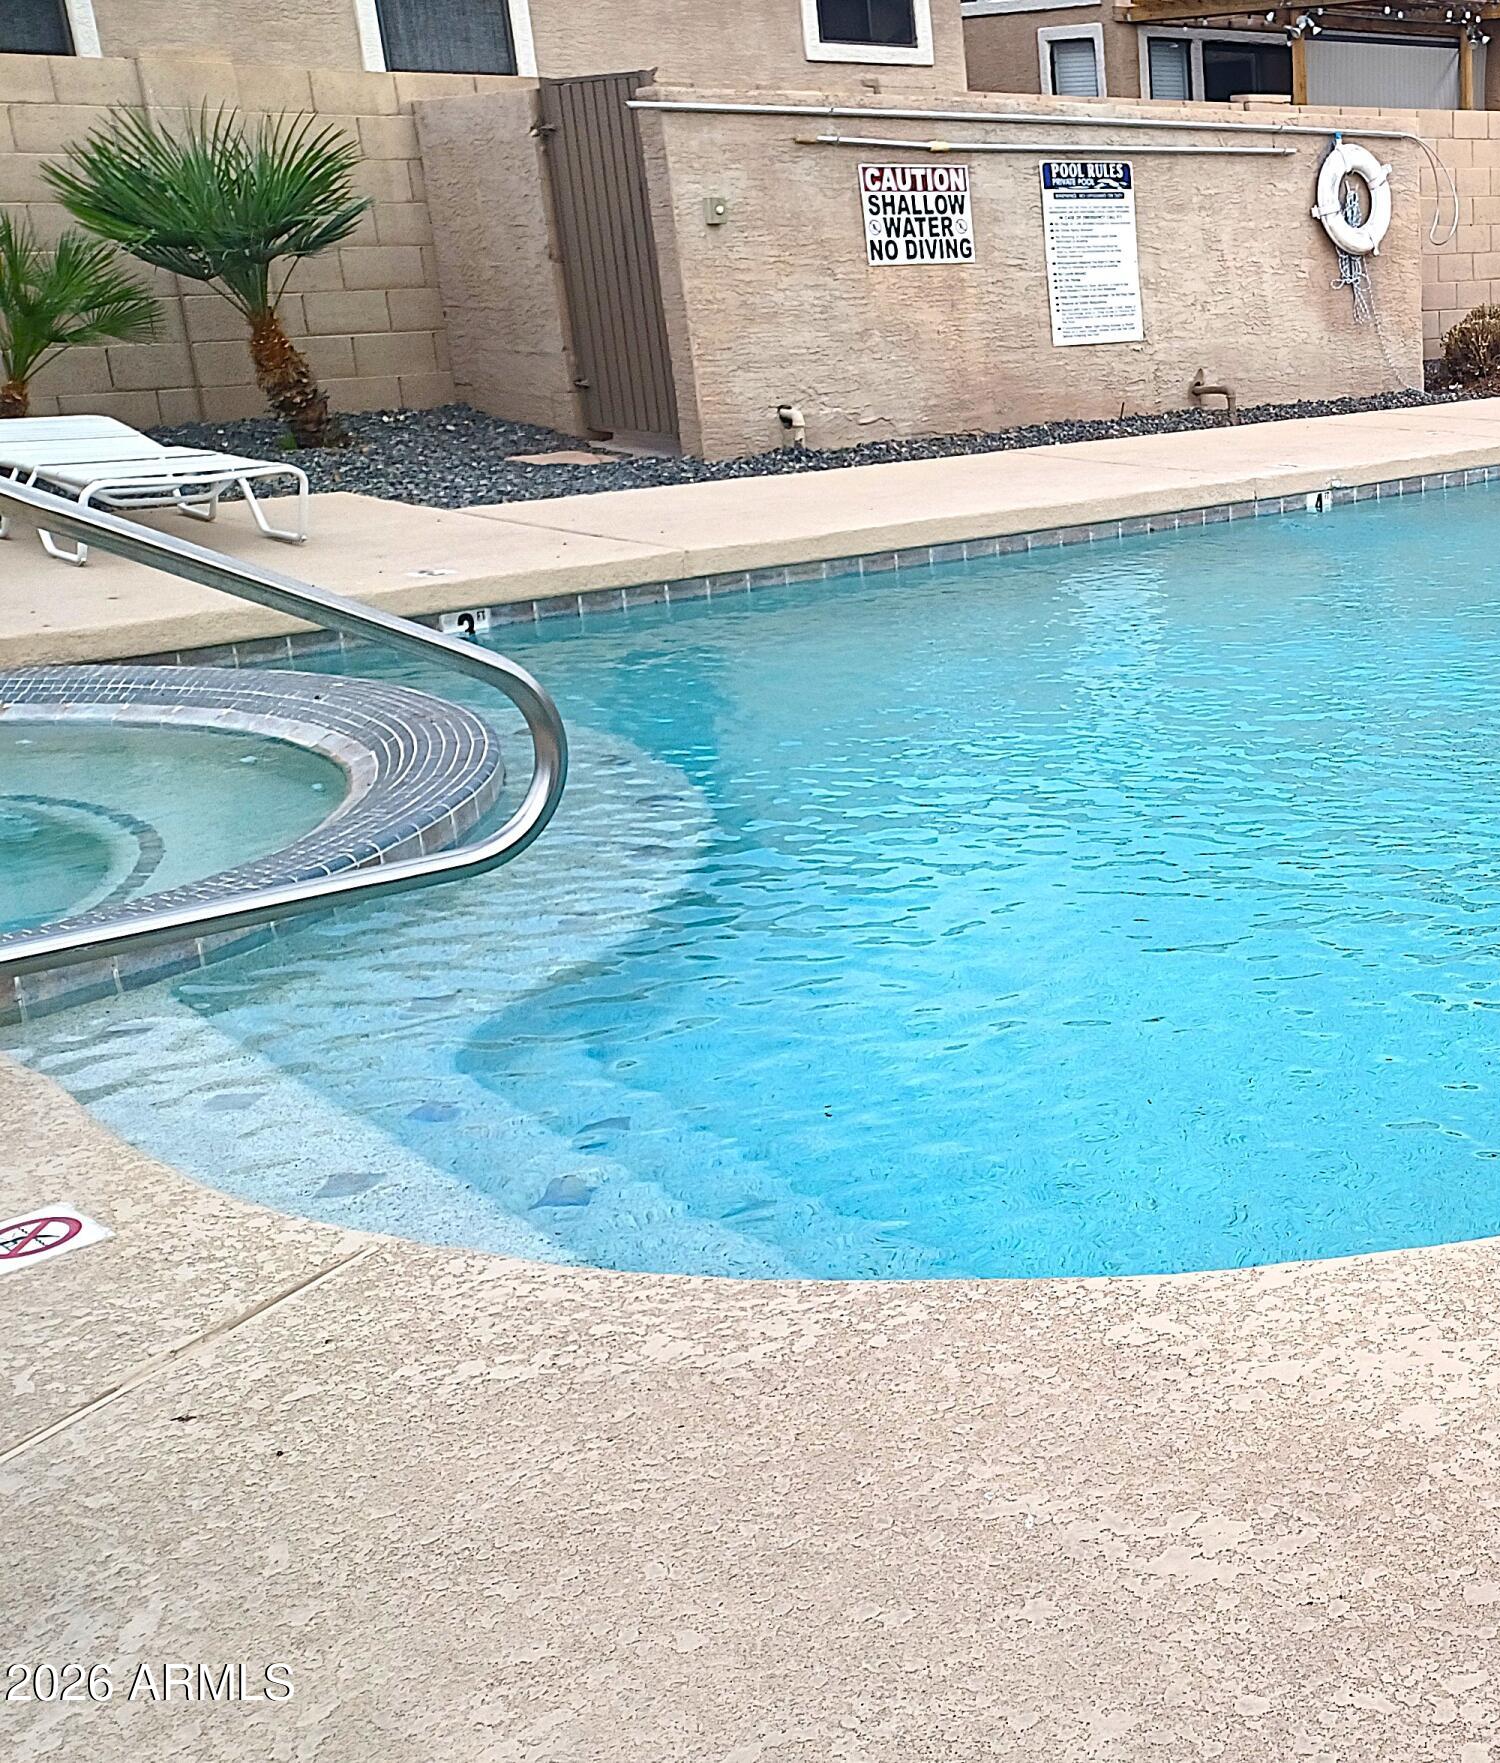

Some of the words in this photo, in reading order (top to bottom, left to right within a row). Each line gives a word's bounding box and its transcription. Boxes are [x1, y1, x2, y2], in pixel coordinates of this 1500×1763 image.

[864, 167, 966, 192] CAUTION
[1050, 163, 1085, 178] POOL
[1087, 163, 1124, 179] RULES
[1078, 178, 1095, 186] POOL
[868, 194, 965, 215] SHALLOW
[883, 216, 954, 238] WATER
[869, 239, 898, 261] NO
[905, 238, 972, 260] DIVING
[476, 610, 485, 621] FT
